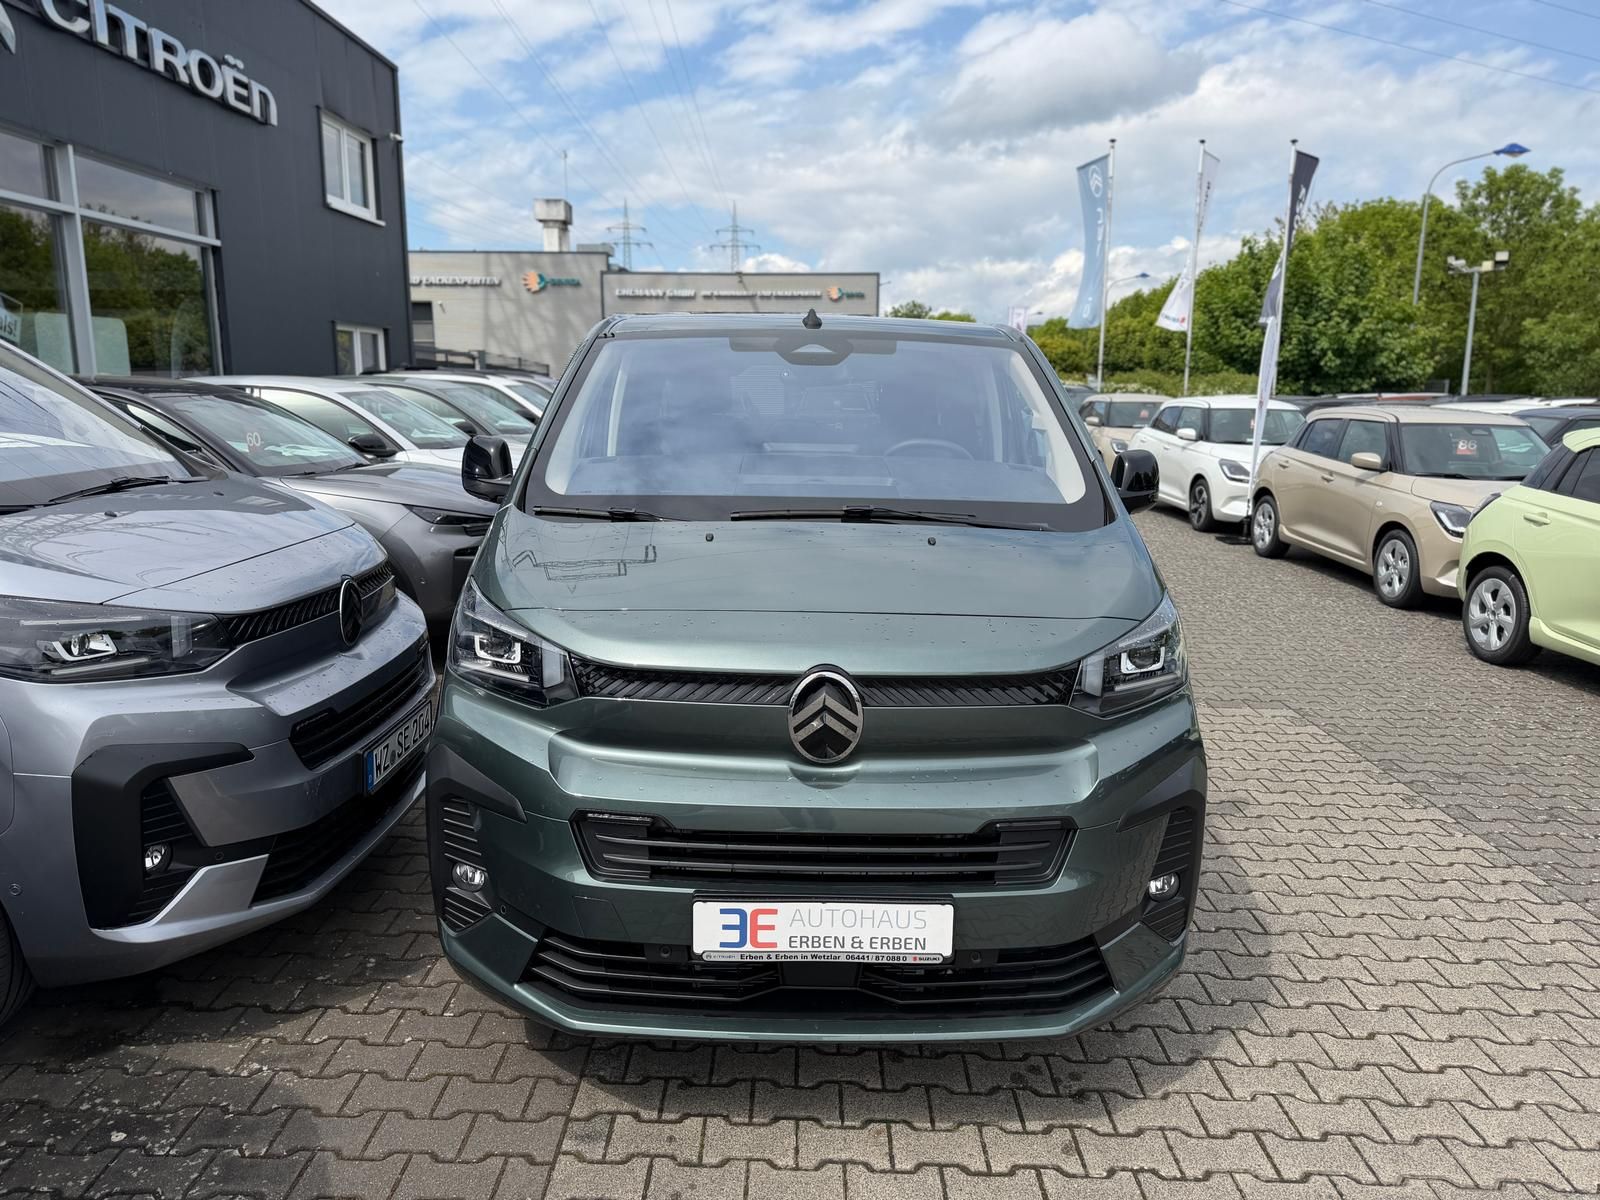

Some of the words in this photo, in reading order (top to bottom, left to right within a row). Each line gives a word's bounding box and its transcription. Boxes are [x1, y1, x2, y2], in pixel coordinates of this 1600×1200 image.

[246, 431, 261, 447] 60
[1458, 439, 1477, 450] 86
[374, 743, 390, 778] WZ
[396, 725, 411, 758] SE
[412, 707, 431, 745] 204
[789, 908, 927, 930] AUTOHAUS
[788, 935, 846, 949] ERBEN
[850, 936, 865, 949] &
[869, 937, 927, 950] ERBEN
